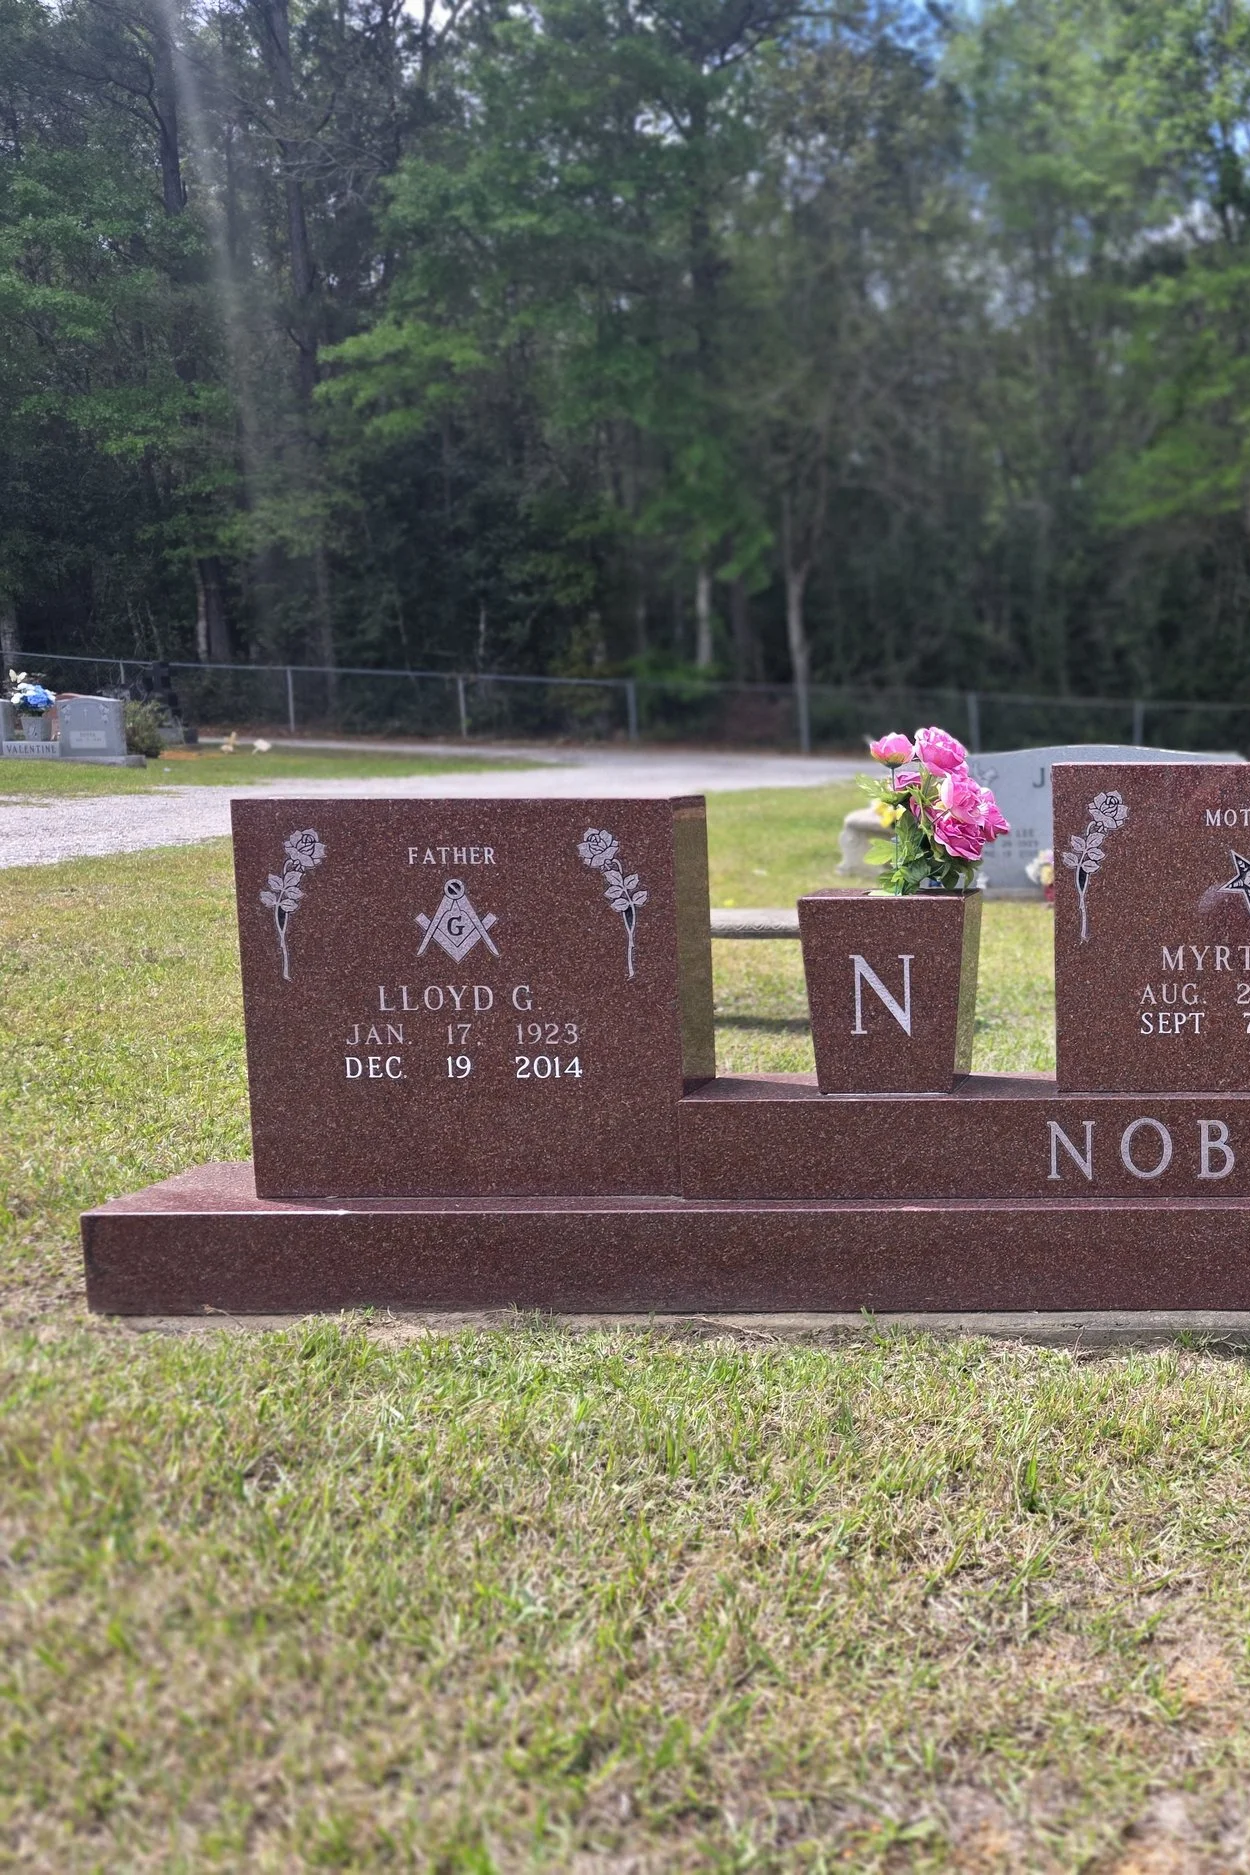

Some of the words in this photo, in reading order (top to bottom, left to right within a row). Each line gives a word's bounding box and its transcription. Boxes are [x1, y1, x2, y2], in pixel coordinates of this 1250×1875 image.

[6, 744, 57, 754] VALENTINE
[407, 846, 497, 865] FATHER
[446, 916, 465, 936] G
[378, 986, 493, 1011] LLOYD
[849, 954, 914, 1037] N
[1140, 983, 1207, 1005] AUG.
[346, 1023, 413, 1045] JAN.
[516, 1023, 579, 1045] 1923
[1140, 1012, 1205, 1034] SEPT
[447, 1055, 472, 1079] 19
[515, 1056, 583, 1079] 2014
